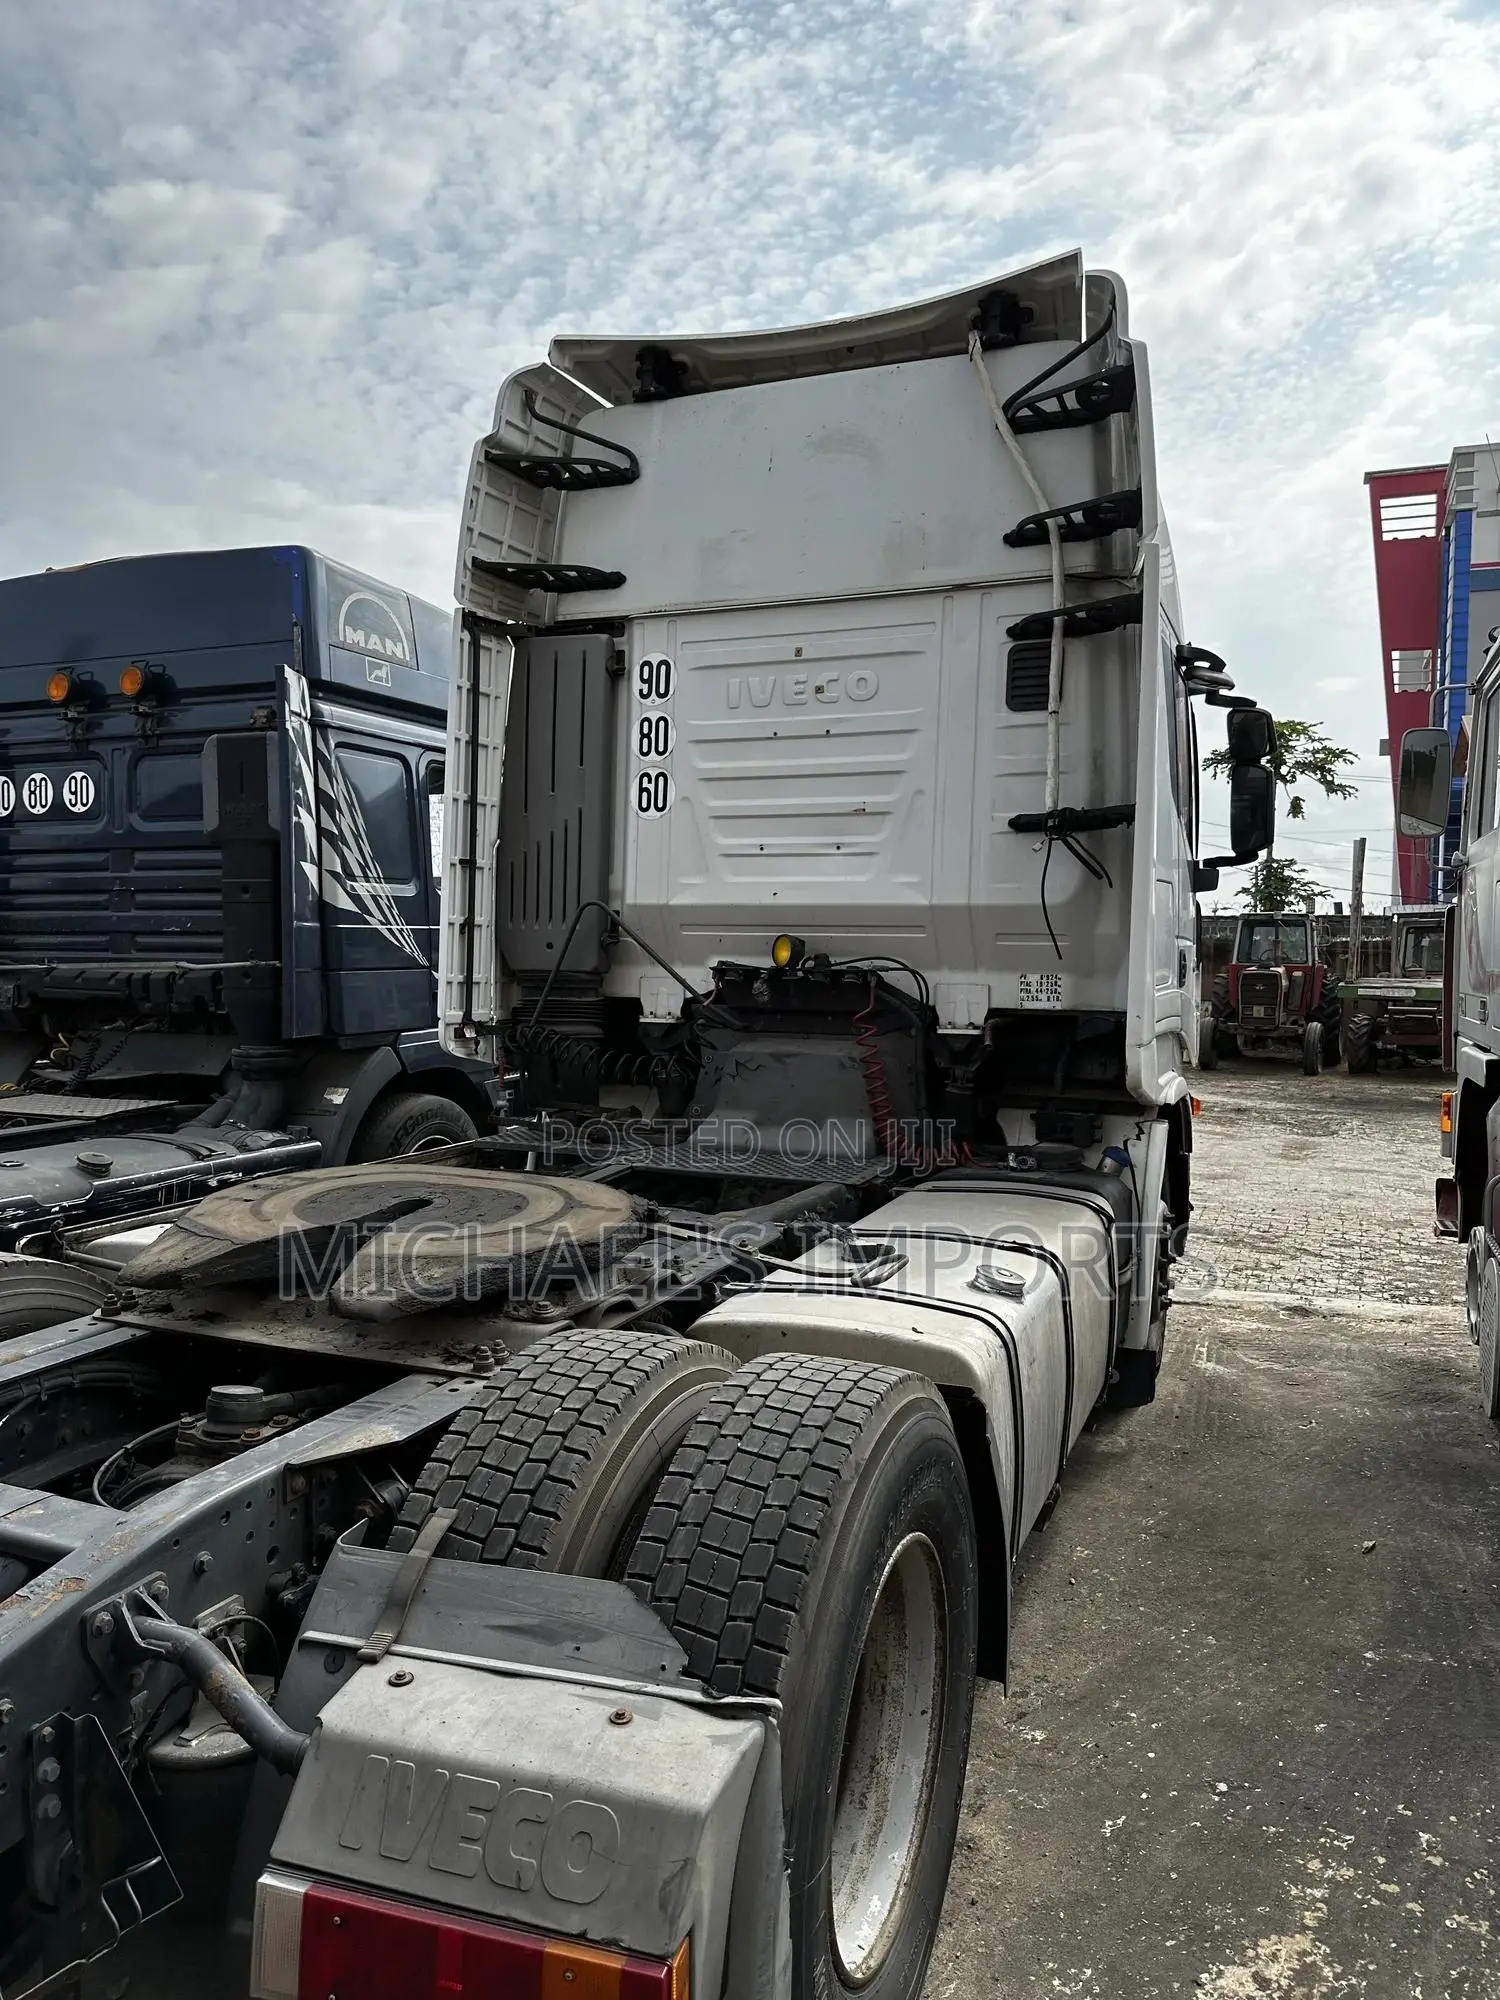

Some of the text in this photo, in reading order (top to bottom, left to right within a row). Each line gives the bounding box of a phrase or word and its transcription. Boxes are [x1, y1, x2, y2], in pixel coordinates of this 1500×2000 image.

[345, 625, 404, 659] MAN
[638, 659, 672, 700] 90
[727, 670, 880, 709] IVECO
[638, 715, 670, 757] 80
[0, 780, 10, 811] 0
[28, 777, 48, 809] 80
[68, 775, 89, 807] 90
[637, 771, 669, 813] 60
[338, 1754, 621, 1905] IVECO
